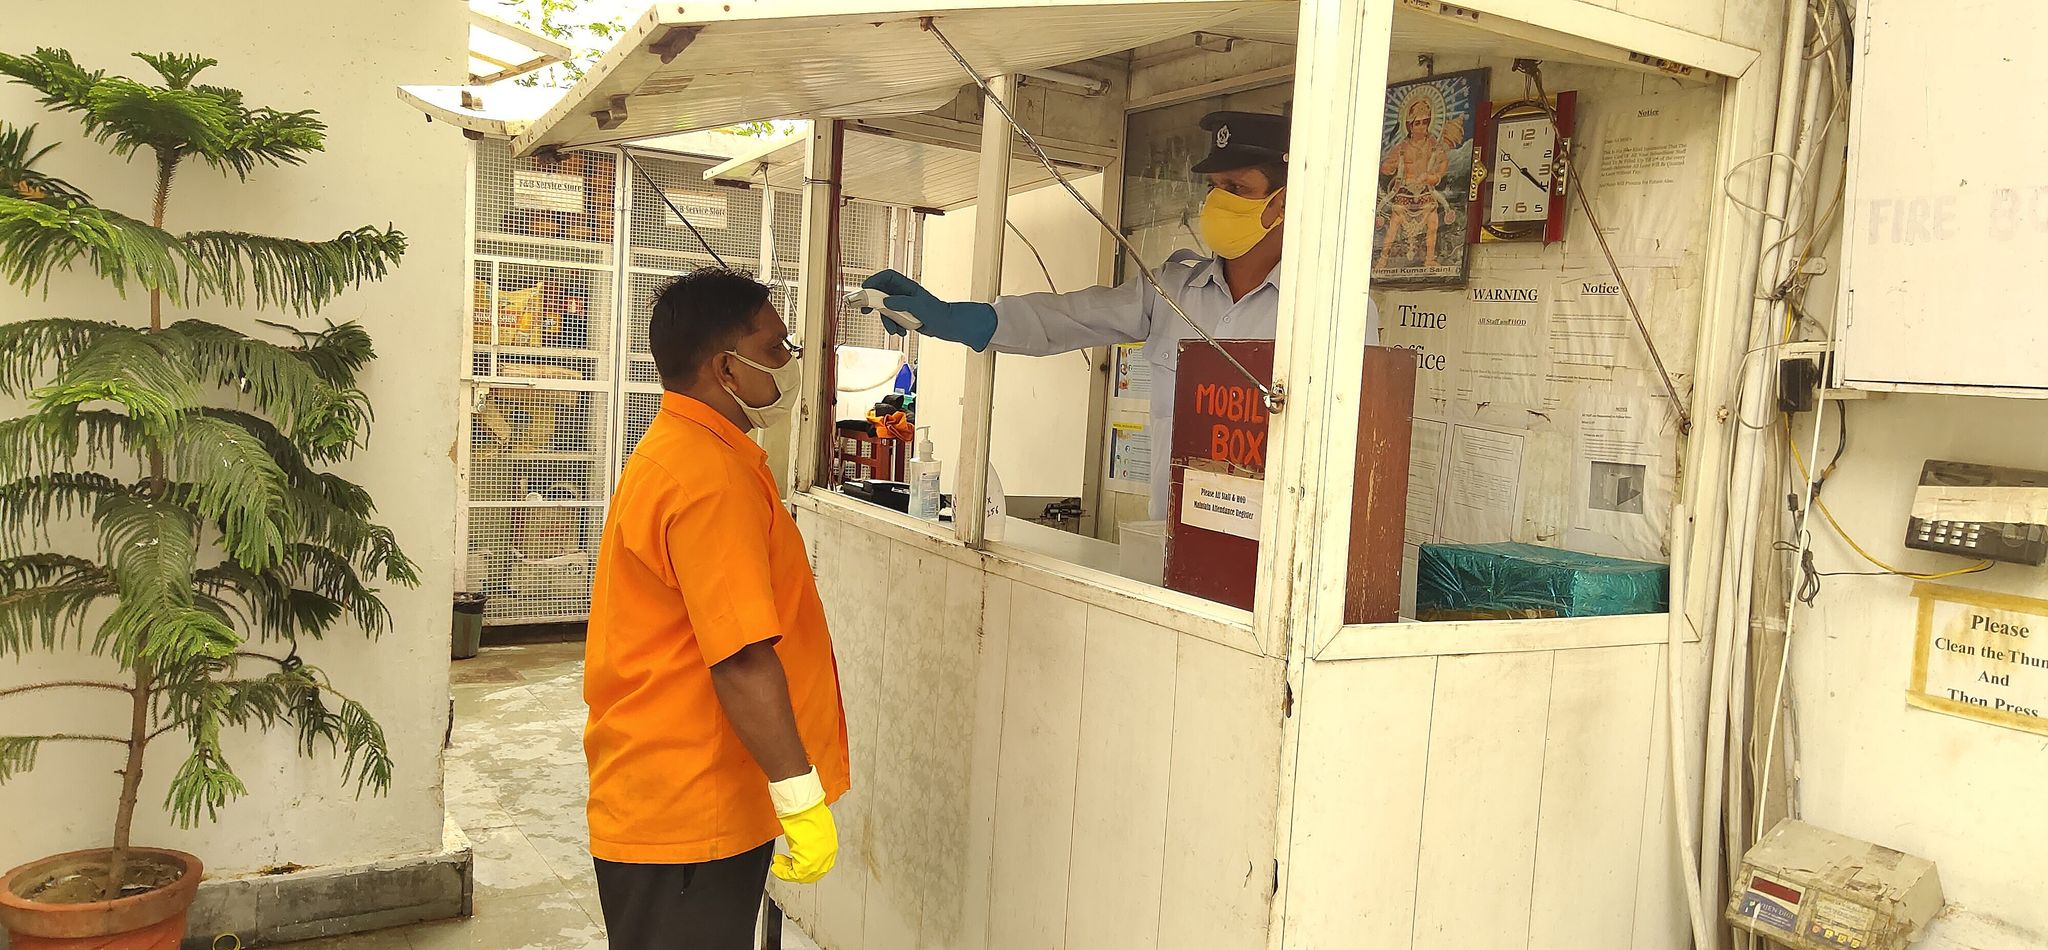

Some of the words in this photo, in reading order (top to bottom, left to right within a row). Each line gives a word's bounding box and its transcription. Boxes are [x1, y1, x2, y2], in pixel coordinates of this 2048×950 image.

[1637, 109, 1660, 118] Notice
[1508, 131, 1514, 139] 11
[1521, 128, 1536, 140] 12
[1501, 153, 1510, 162] 10
[1544, 150, 1552, 158] 2
[1501, 167, 1512, 178] 9
[1539, 164, 1550, 175] 3
[536, 180, 562, 191] Service
[563, 182, 582, 193] Store
[1501, 206, 1509, 214] 7
[1515, 202, 1527, 213] 6
[1581, 282, 1619, 294] Notice
[1473, 288, 1538, 301] WARNING
[1398, 304, 1447, 330] Time
[1211, 424, 1264, 465] BOX
[1200, 487, 1215, 498] Please
[1211, 503, 1235, 516] Attendance
[1235, 508, 1254, 520] Register
[1970, 614, 2030, 639] Please
[1934, 636, 1975, 656] Clean
[1980, 646, 2004, 661] the
[1977, 670, 2010, 687] And
[1947, 687, 1988, 708] Then
[1995, 698, 2039, 718] Press
